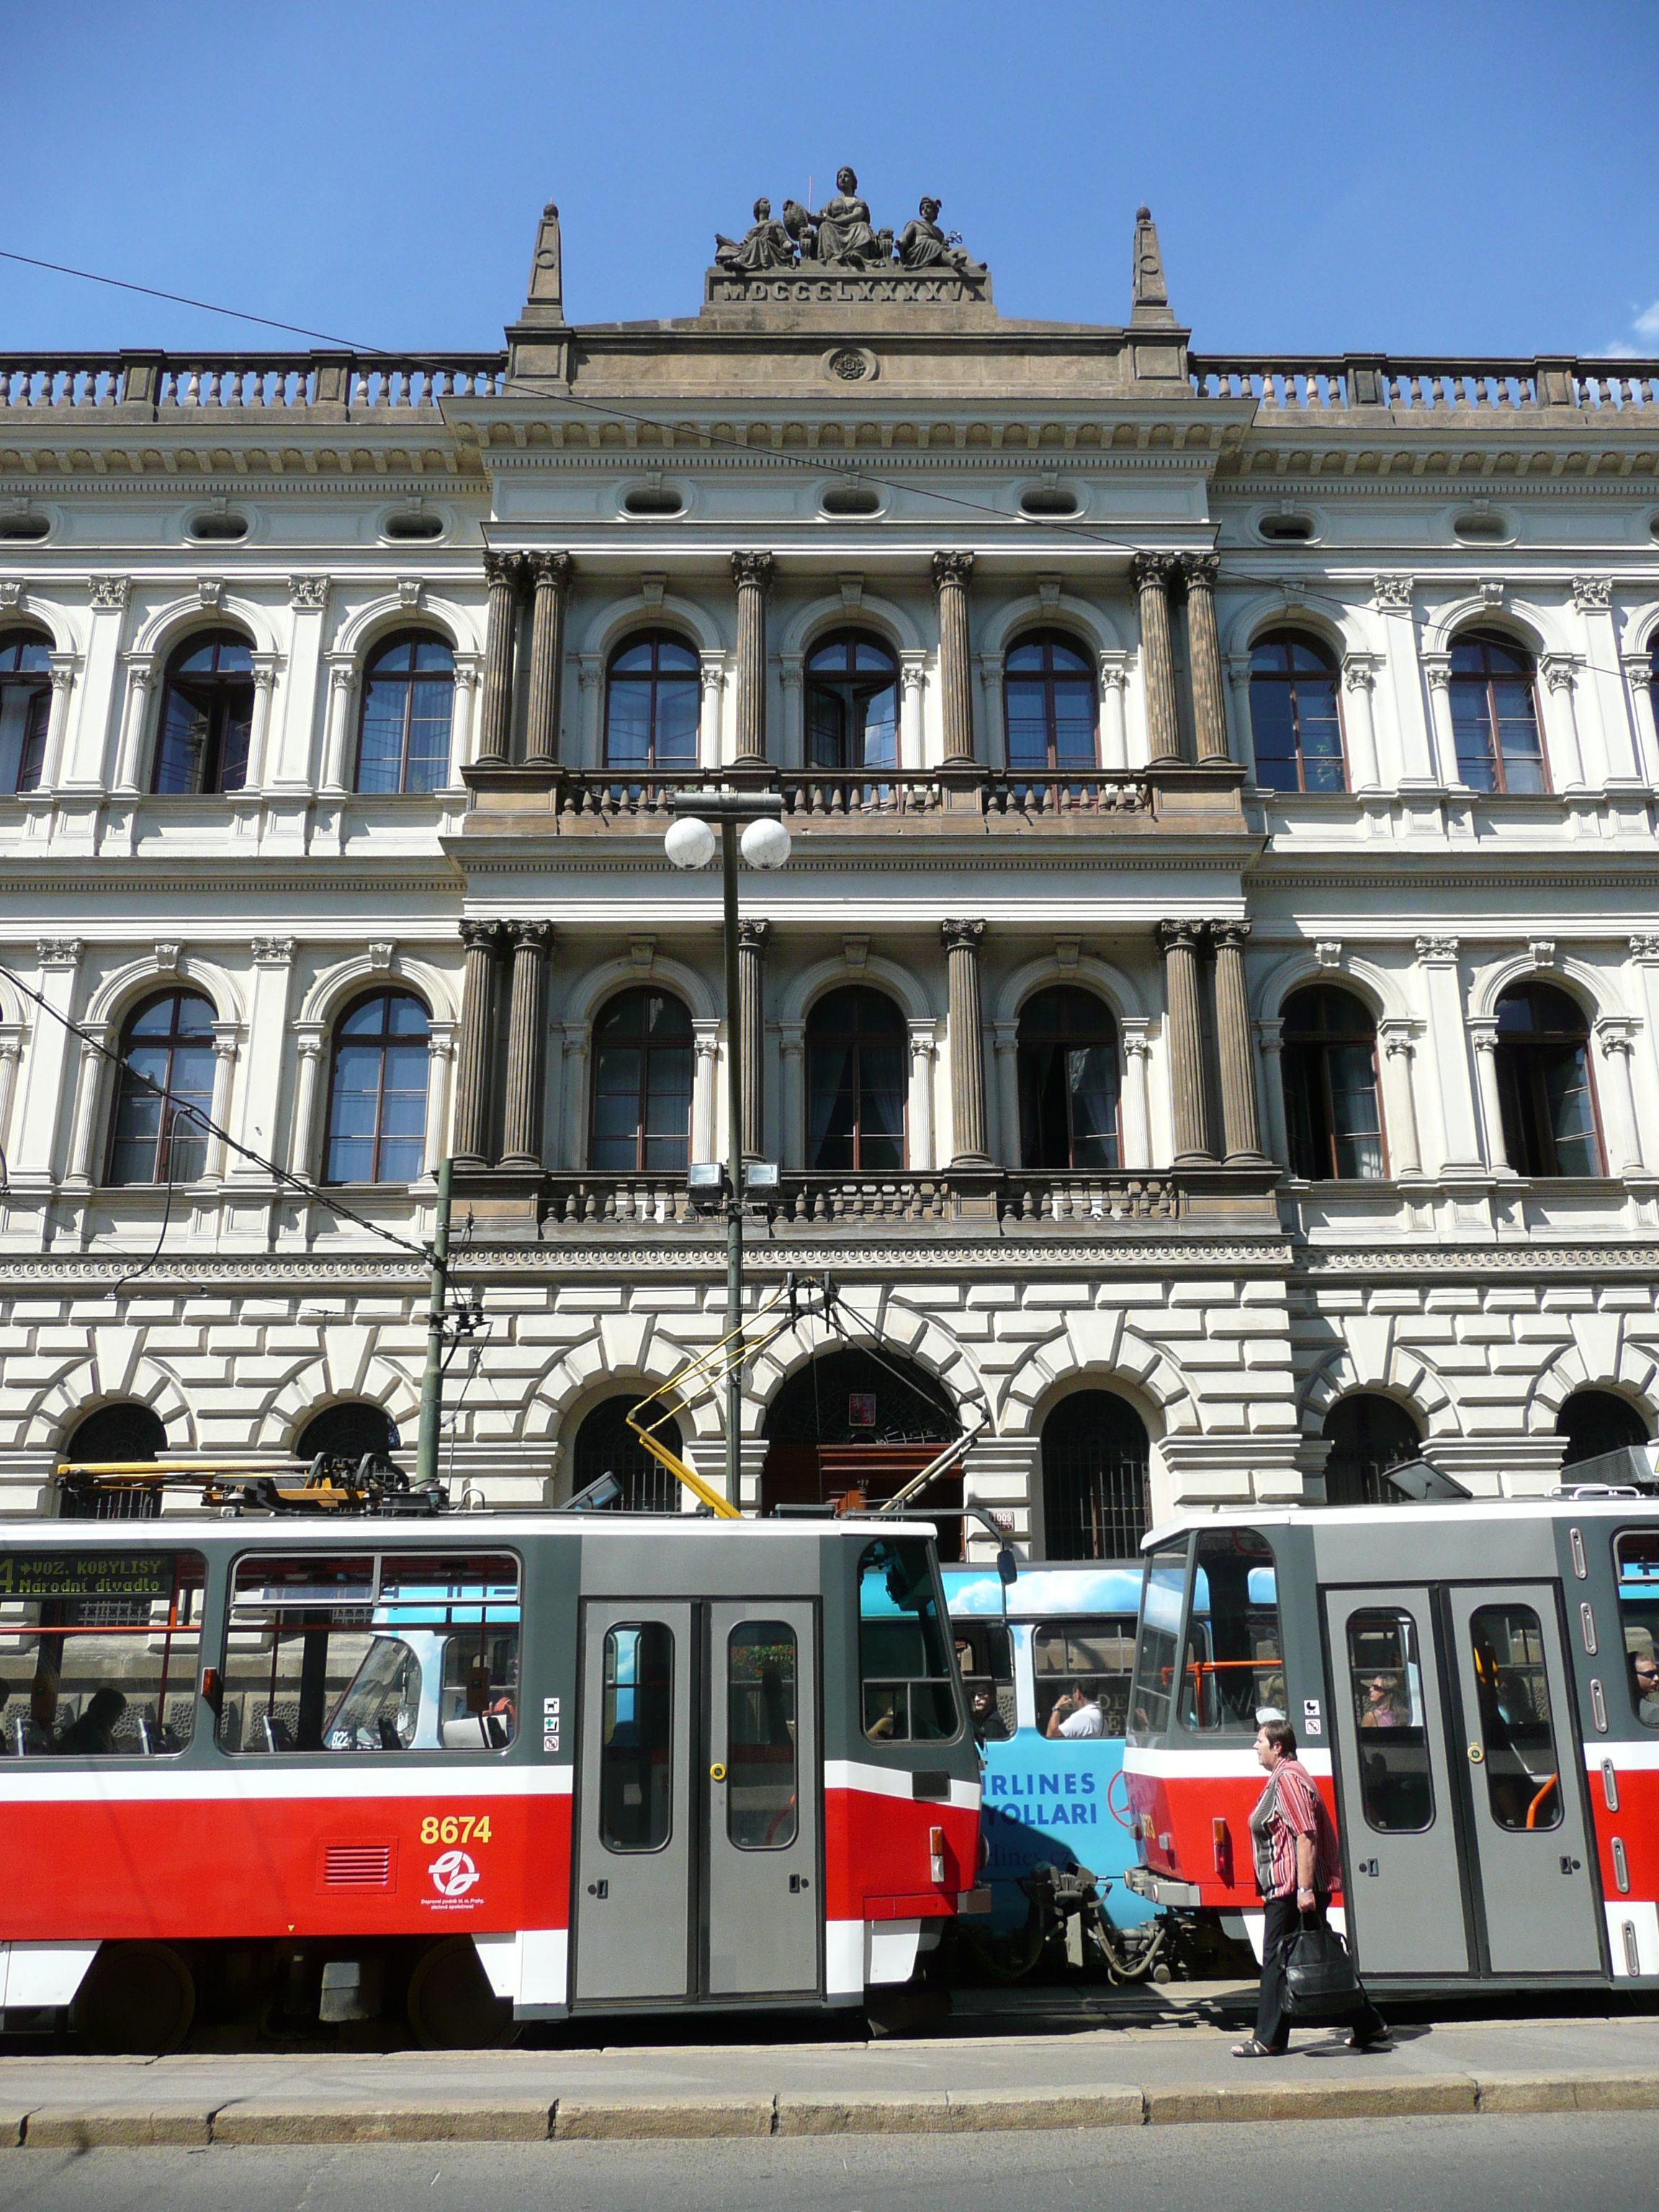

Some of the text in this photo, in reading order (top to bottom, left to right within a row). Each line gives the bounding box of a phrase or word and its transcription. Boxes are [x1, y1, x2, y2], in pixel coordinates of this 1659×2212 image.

[992, 1513, 1012, 1522] 1009
[32, 1560, 161, 1575] VOZ. KOBYLISY
[19, 1577, 160, 1593] Národní divadlo
[982, 1773, 1095, 1796] IRLINES
[984, 1803, 1097, 1826] YOLLARI
[420, 1815, 493, 1845] 8674
